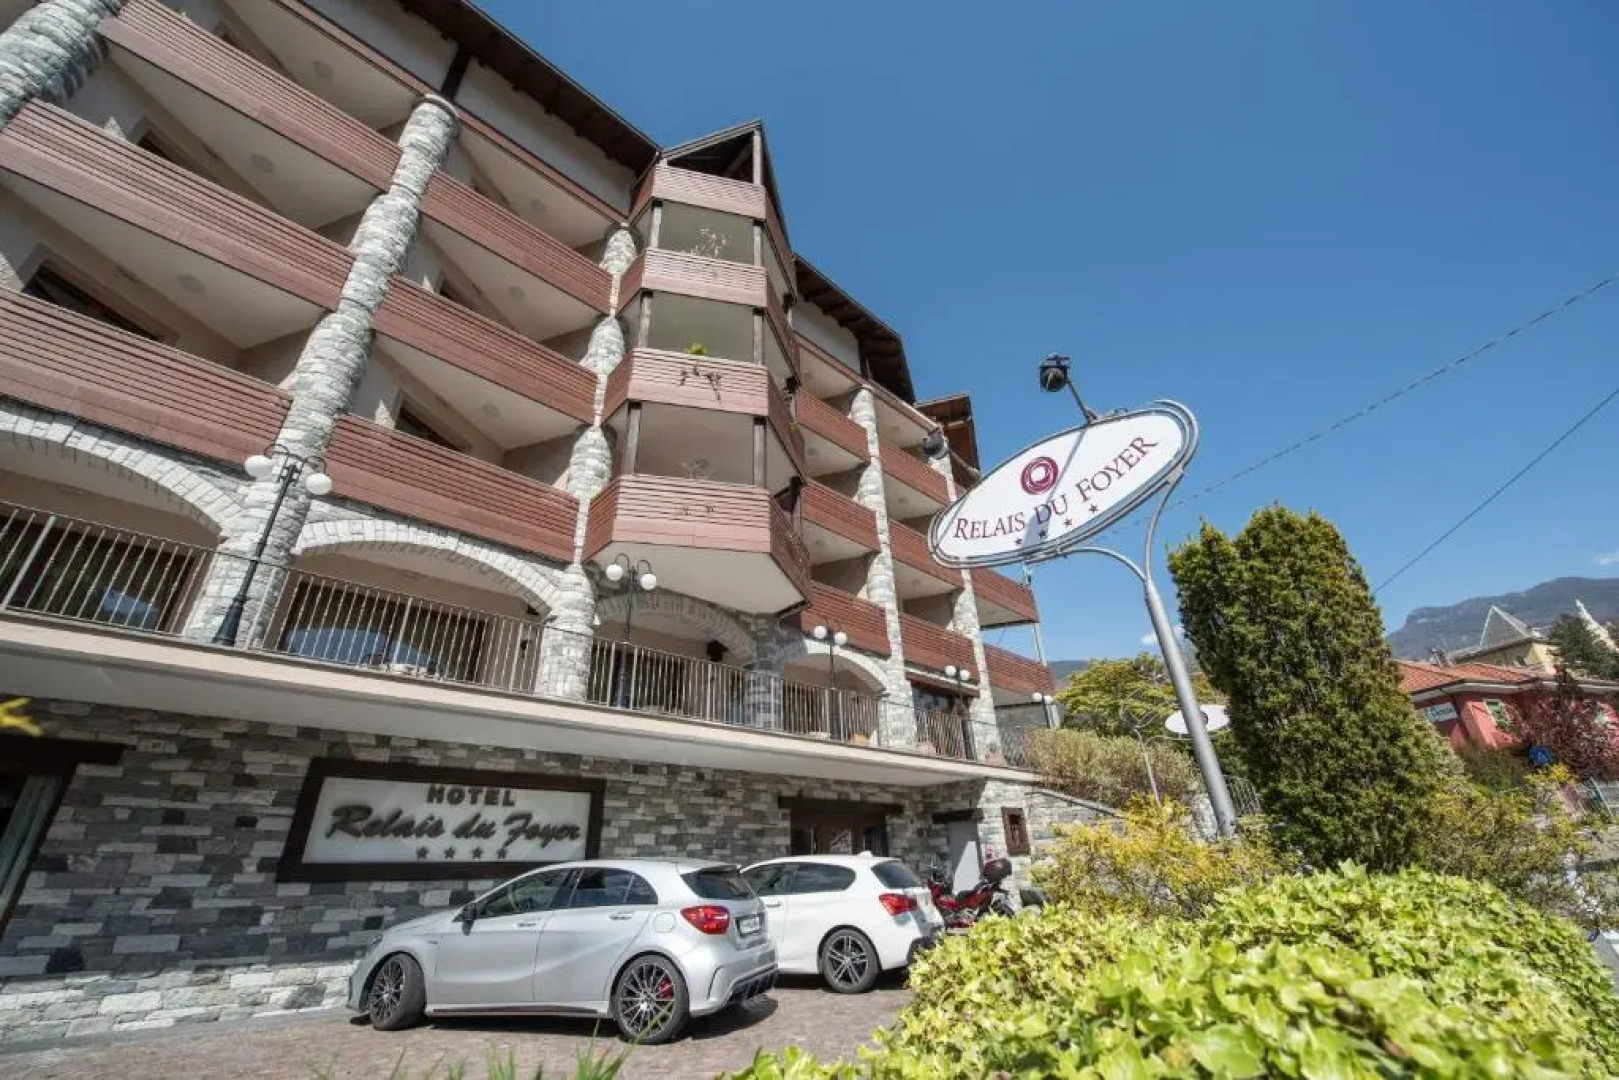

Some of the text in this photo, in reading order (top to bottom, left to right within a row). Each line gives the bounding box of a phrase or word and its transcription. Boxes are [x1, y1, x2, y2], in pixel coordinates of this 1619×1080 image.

[953, 437, 1159, 540] RELAIS DU FOYER
[427, 786, 516, 806] HOTEL
[325, 804, 580, 848] Relais du Foyer
